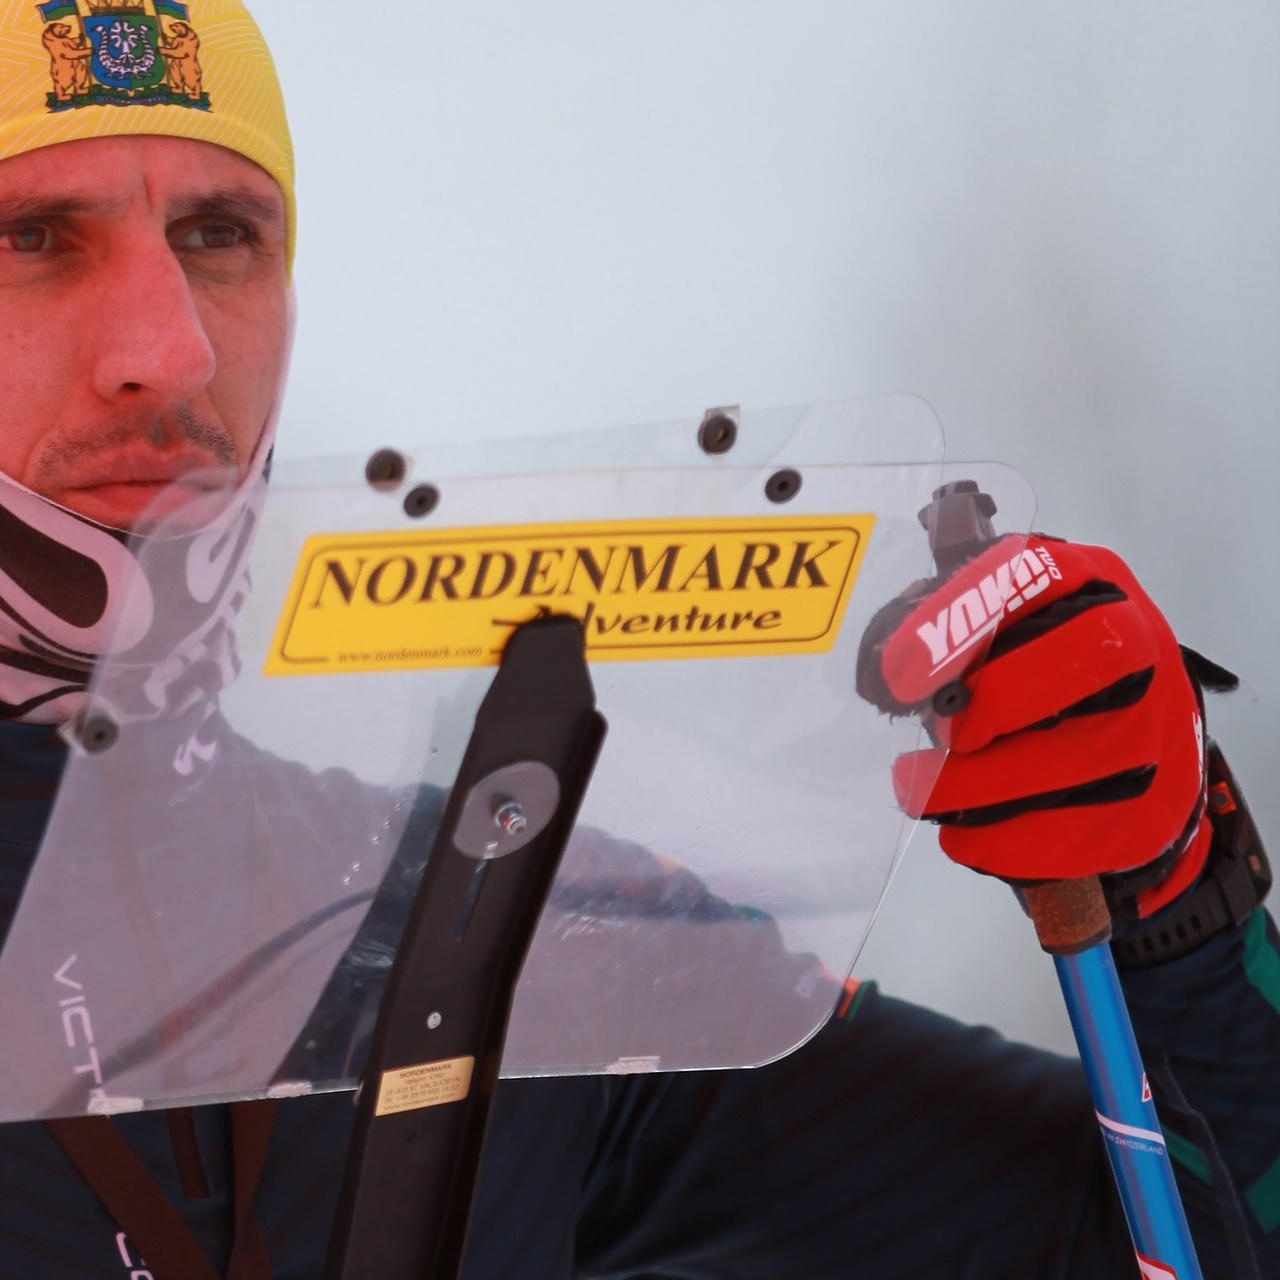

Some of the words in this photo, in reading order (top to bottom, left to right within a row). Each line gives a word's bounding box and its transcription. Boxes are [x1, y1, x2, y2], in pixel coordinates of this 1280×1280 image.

[310, 538, 843, 609] NORDENMARK
[339, 646, 483, 663] www.nordenmark.com
[1115, 1136, 1164, 1156] SWITZERLAND
